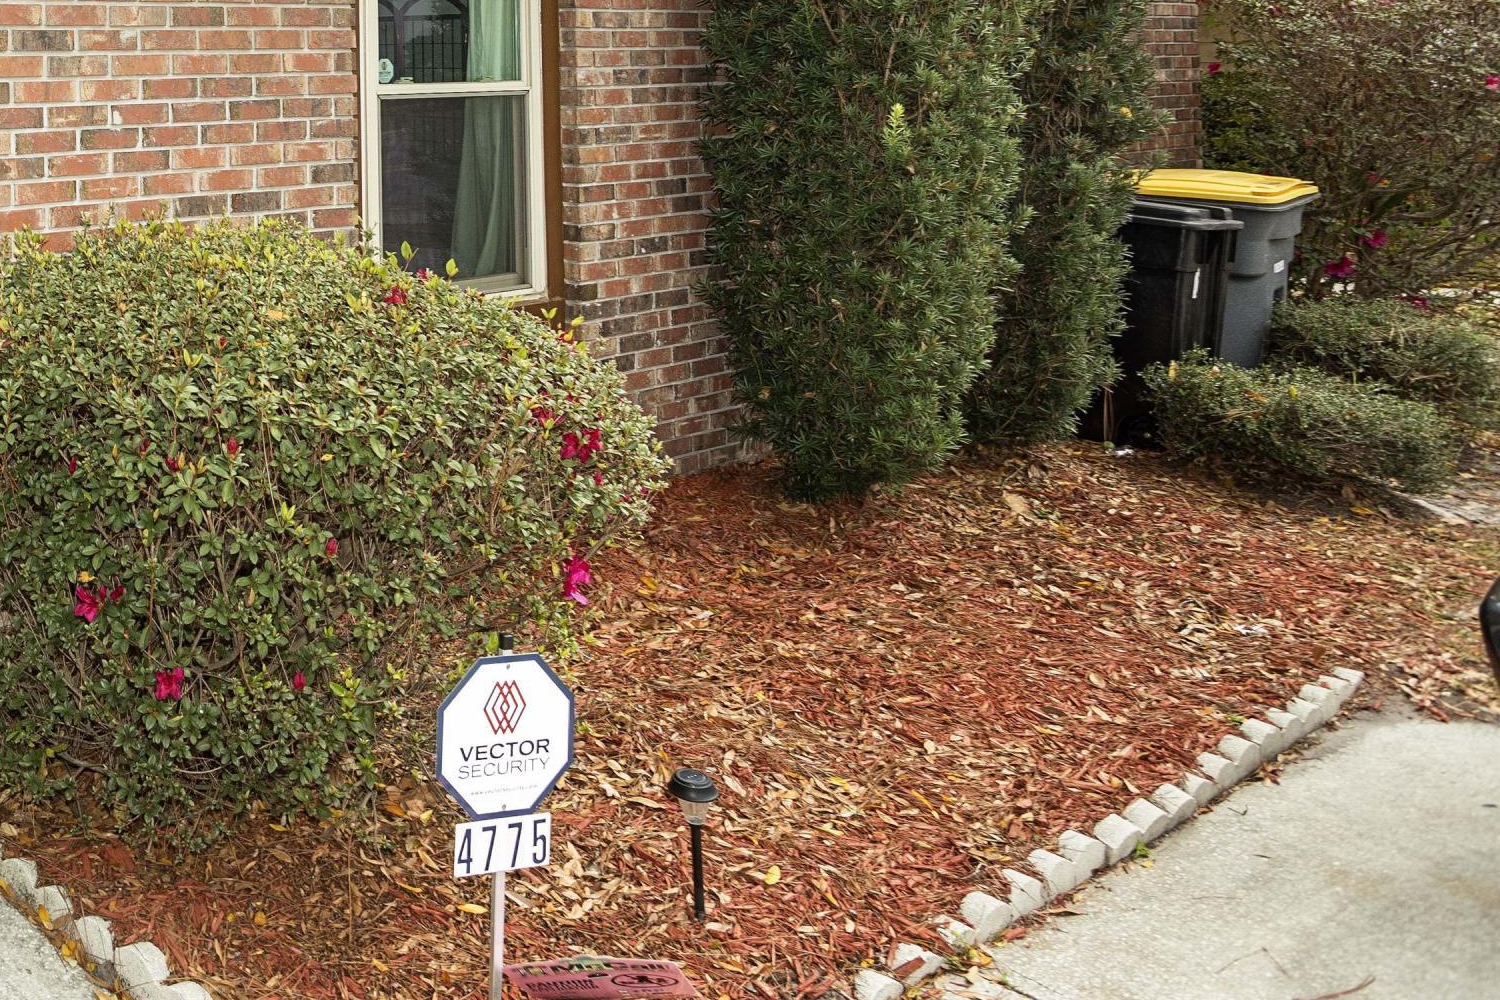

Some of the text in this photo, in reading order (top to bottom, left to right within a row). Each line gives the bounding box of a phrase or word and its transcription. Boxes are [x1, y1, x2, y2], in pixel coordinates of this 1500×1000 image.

[460, 738, 550, 762] VECTOR
[458, 757, 550, 779] SECURITY
[457, 818, 547, 874] 4775
